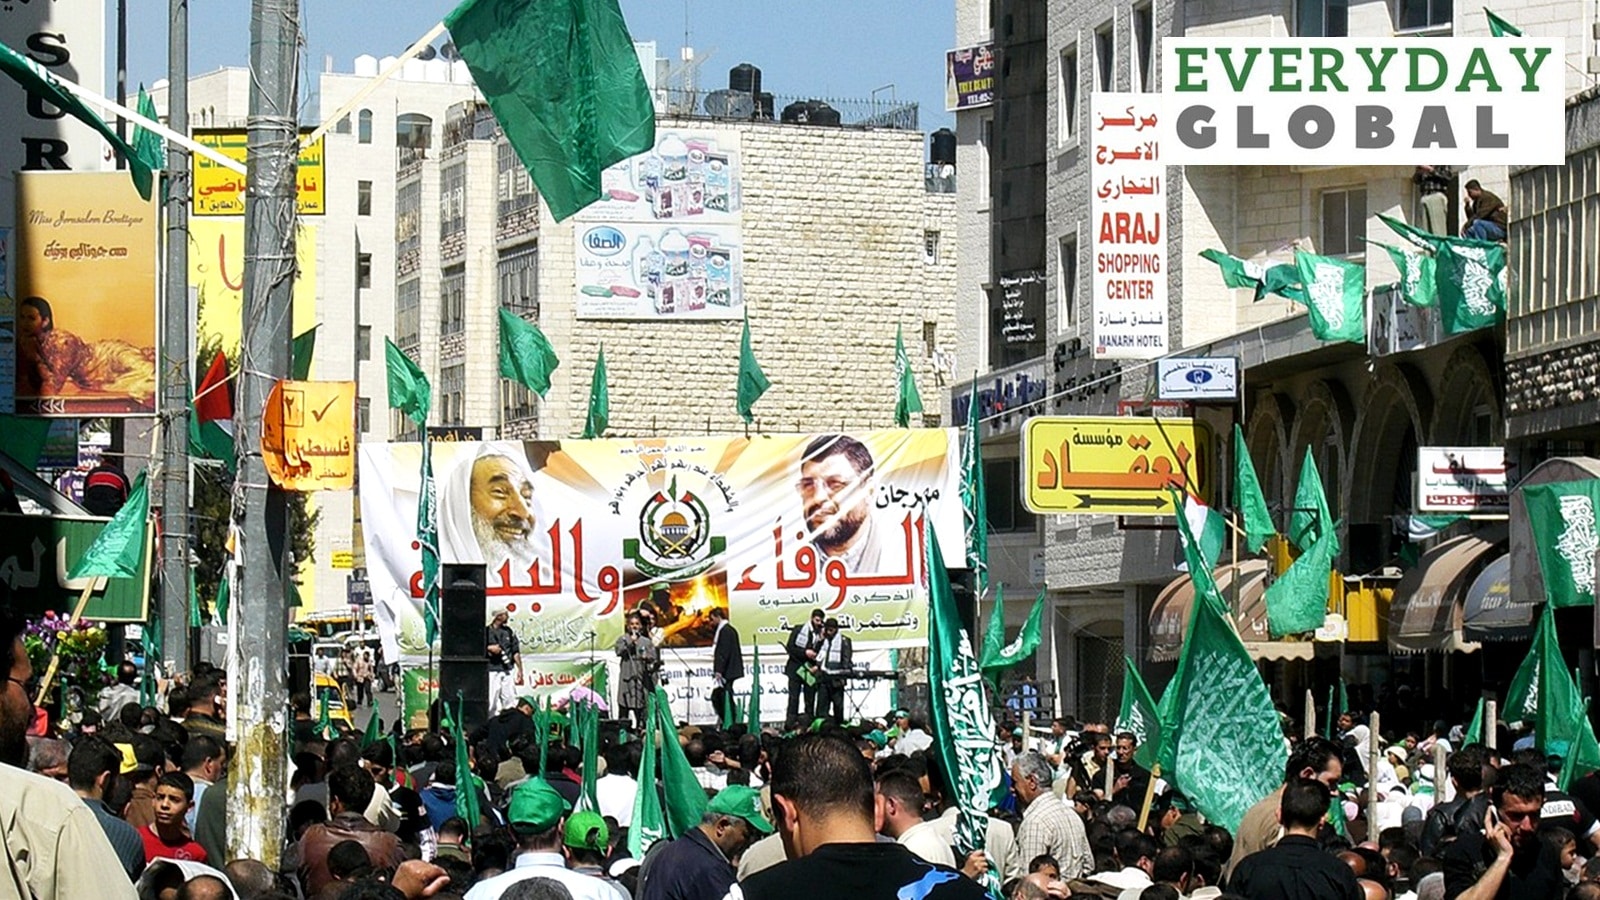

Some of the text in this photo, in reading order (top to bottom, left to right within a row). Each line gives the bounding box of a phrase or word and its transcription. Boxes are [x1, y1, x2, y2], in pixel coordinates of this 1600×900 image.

[1097, 106, 1158, 132] مركز
[1096, 141, 1159, 165] الاعرج
[1097, 175, 1160, 203] التجاري
[200, 200, 205, 209] 1
[29, 209, 144, 227] Miss Jerusalem Boutique
[1099, 212, 1160, 245] ARAJ
[588, 233, 620, 249] الصفا
[1098, 253, 1160, 274] SHOPPING
[1107, 280, 1154, 300] CENTER
[1099, 311, 1163, 328] فندق منارة
[1099, 334, 1163, 348] MANARH HOTEL
[1072, 428, 1123, 448] مؤسسة
[876, 485, 940, 509] مهرجان
[1447, 496, 1458, 504] 12
[409, 511, 928, 616] الوفاء والبية
[758, 589, 914, 609] الذكرى السنوية
